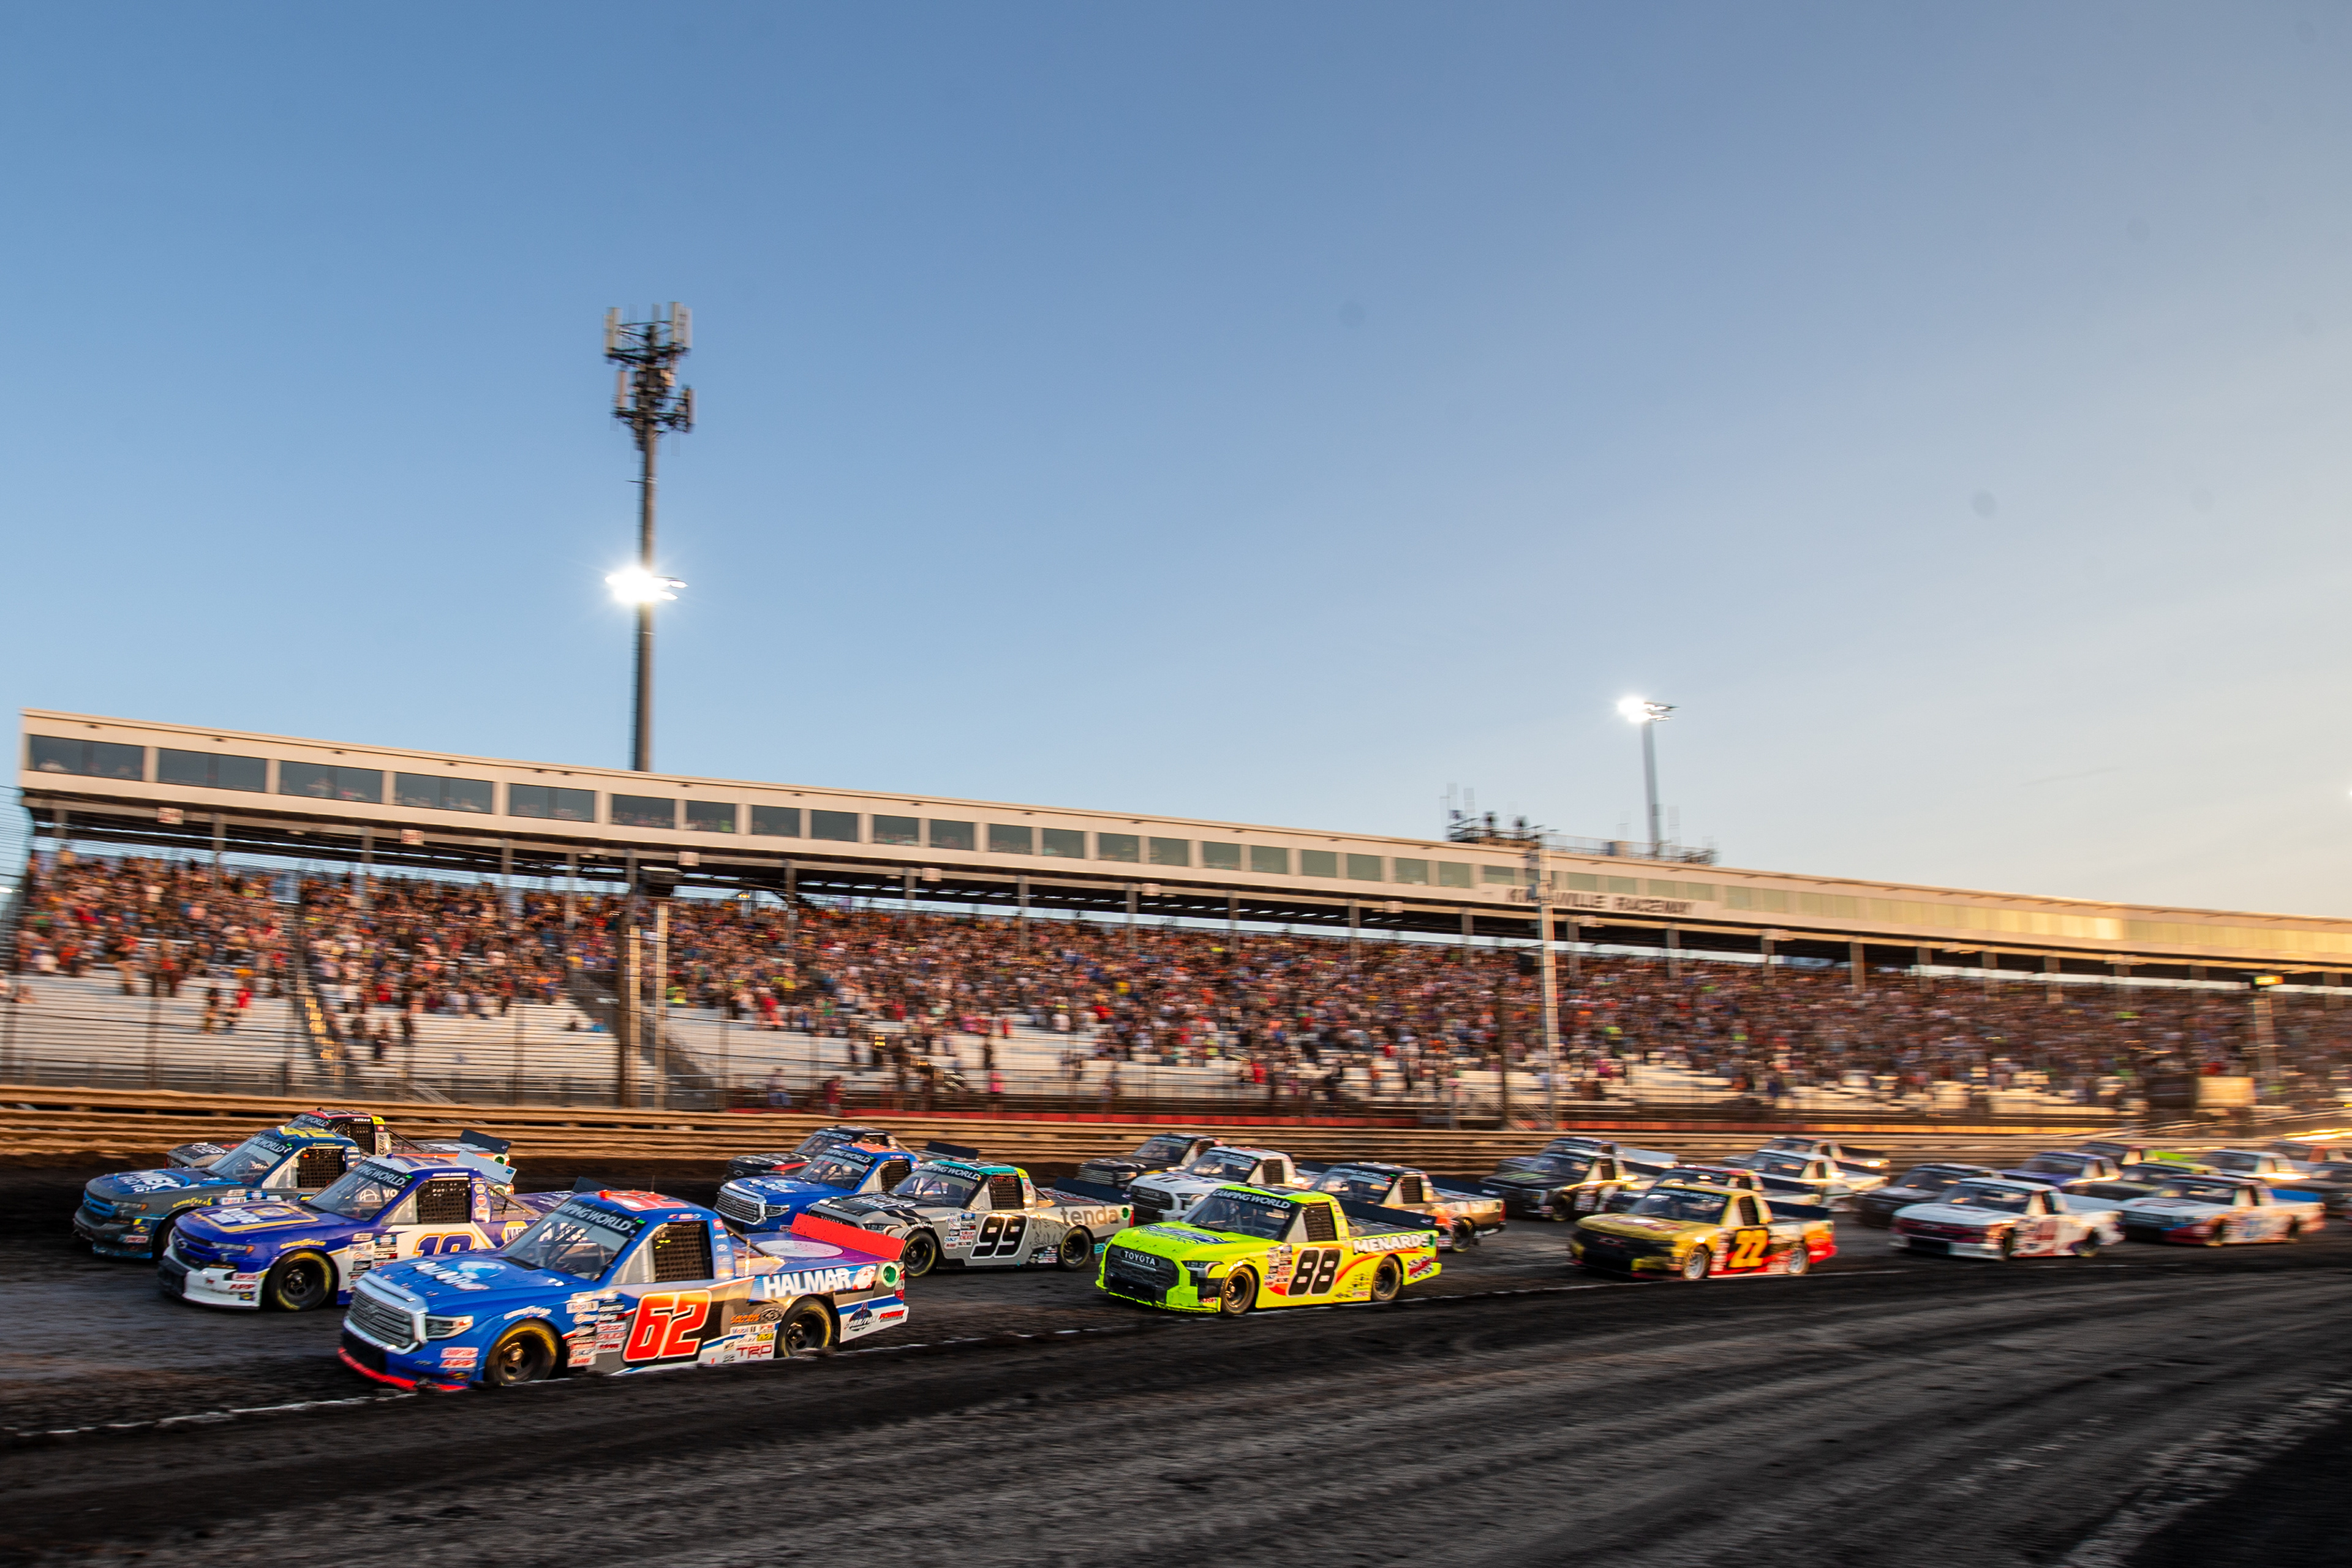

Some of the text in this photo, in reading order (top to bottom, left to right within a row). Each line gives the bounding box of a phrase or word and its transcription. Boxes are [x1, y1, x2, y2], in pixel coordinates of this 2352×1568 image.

[260, 1140, 284, 1153] WORLD
[845, 1153, 871, 1163] WORLD
[371, 1169, 407, 1186] WORLD
[948, 1167, 981, 1180] WORLD
[172, 1197, 213, 1208] GOODYEAR
[1212, 1189, 1291, 1209] CAMPING WORLD
[586, 1211, 635, 1231] WORLD
[1060, 1207, 1120, 1226] tenda
[970, 1215, 1029, 1259] 99
[1352, 1233, 1430, 1255] MENARDS
[1728, 1228, 1769, 1268] 22
[1124, 1251, 1156, 1266] TOYOTA
[1286, 1247, 1343, 1298] 88
[763, 1267, 852, 1299] HALMAR
[622, 1289, 712, 1363] 62
[736, 1344, 772, 1359] TRD
